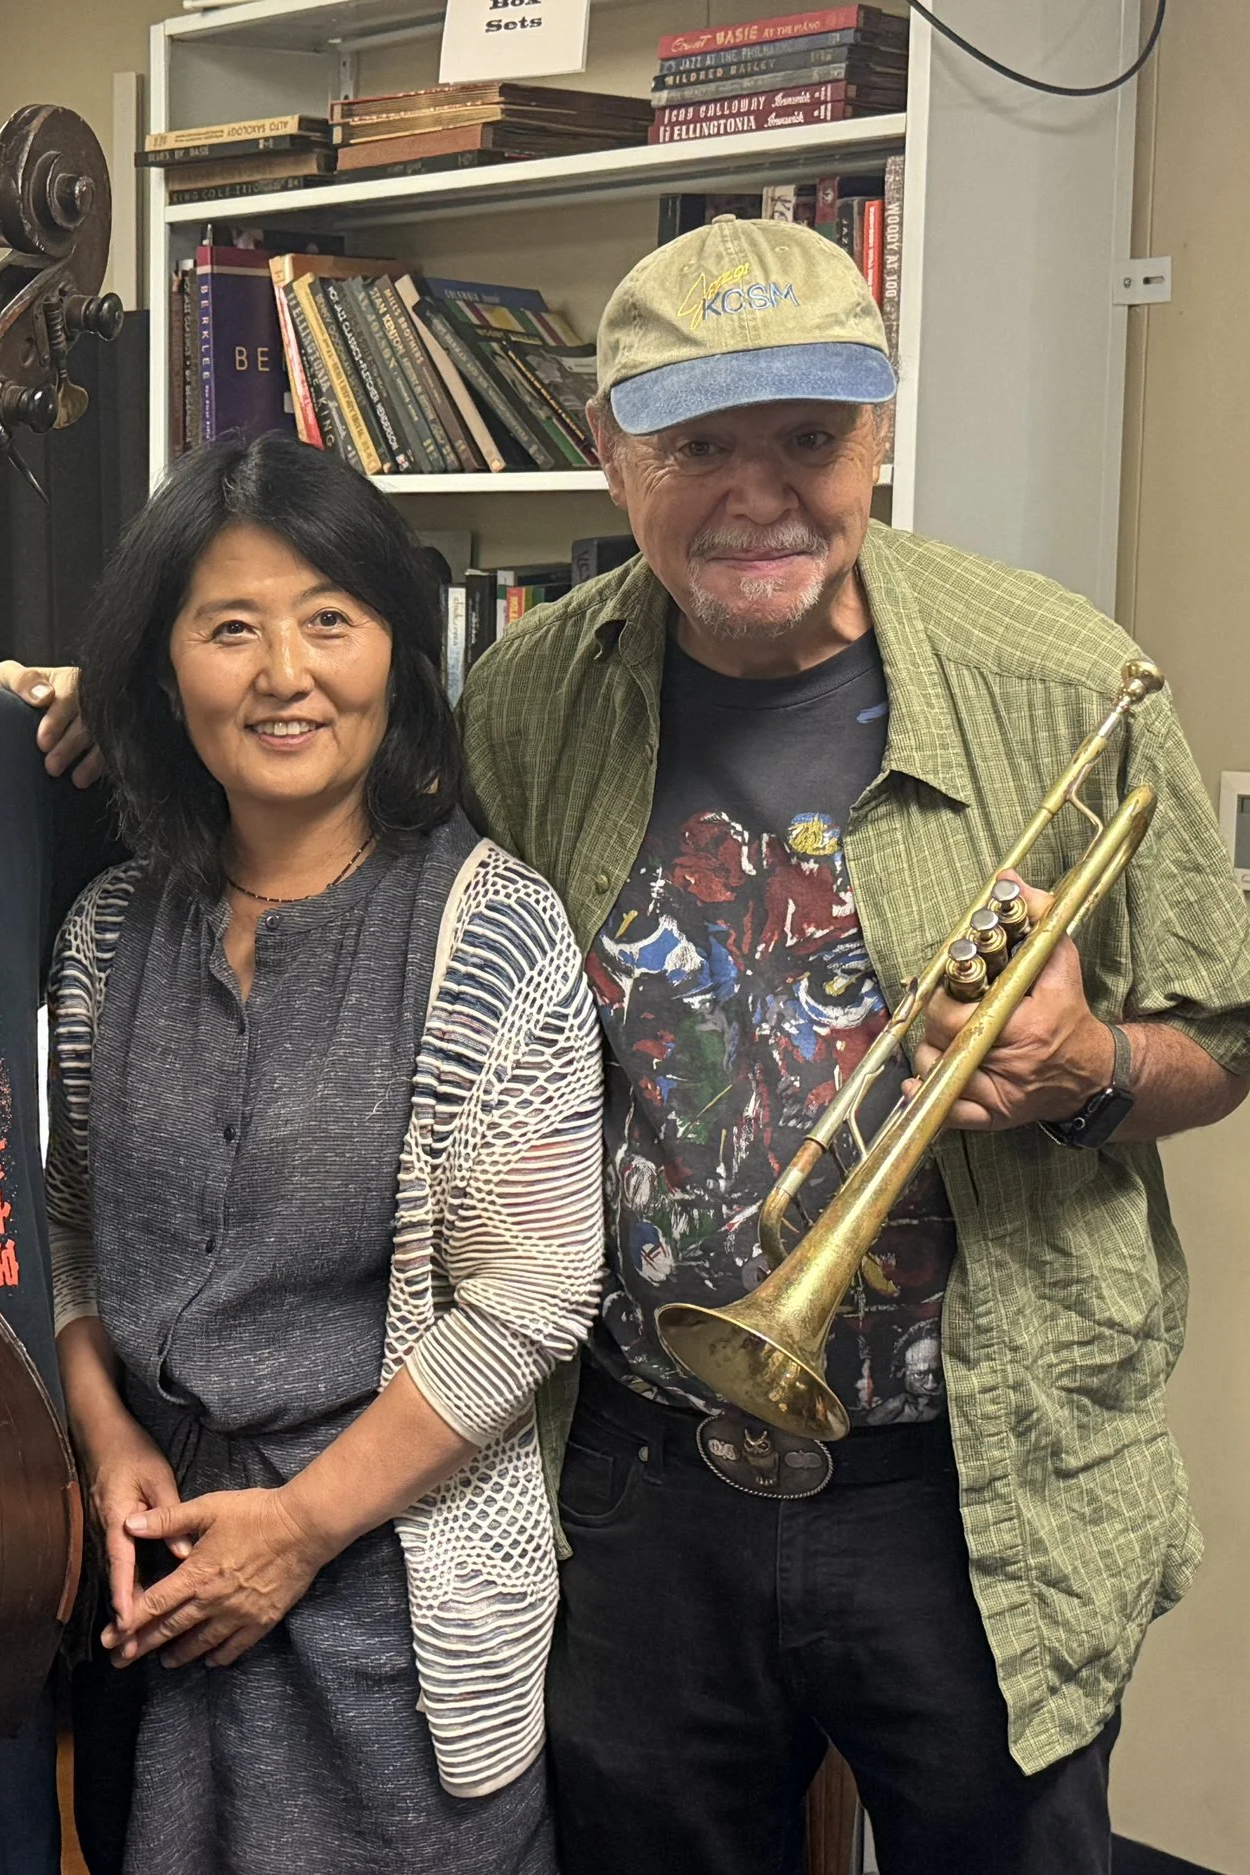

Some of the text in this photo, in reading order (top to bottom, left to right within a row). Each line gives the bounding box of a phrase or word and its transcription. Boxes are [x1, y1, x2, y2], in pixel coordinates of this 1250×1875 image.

[485, 16, 543, 33] Sets
[715, 26, 759, 46] BASIE
[776, 26, 792, 36] THE
[792, 21, 821, 34] PIANO
[665, 58, 777, 86] MILDRED BAILEY
[679, 56, 701, 70] JAZZ
[705, 55, 716, 67] AT
[721, 51, 736, 64] THE
[671, 107, 694, 123] CAB
[699, 96, 766, 118] CALLOWAY
[673, 115, 756, 140] ELLINGTONIA
[885, 201, 900, 299] WOODY AT 100
[370, 286, 388, 314] STAN
[382, 313, 405, 355] KENTON
[702, 282, 800, 321] KCSM
[201, 285, 210, 380] BERKLEE
[293, 306, 331, 392] ELLINGTONIA
[384, 288, 400, 317] MILLS
[399, 317, 424, 365] BROTHERS
[334, 302, 346, 321] JAZZ
[341, 321, 362, 361] CLASSICS
[358, 363, 380, 403] FLETCHER
[375, 402, 399, 450] HENDERSON
[317, 396, 335, 448] KING
